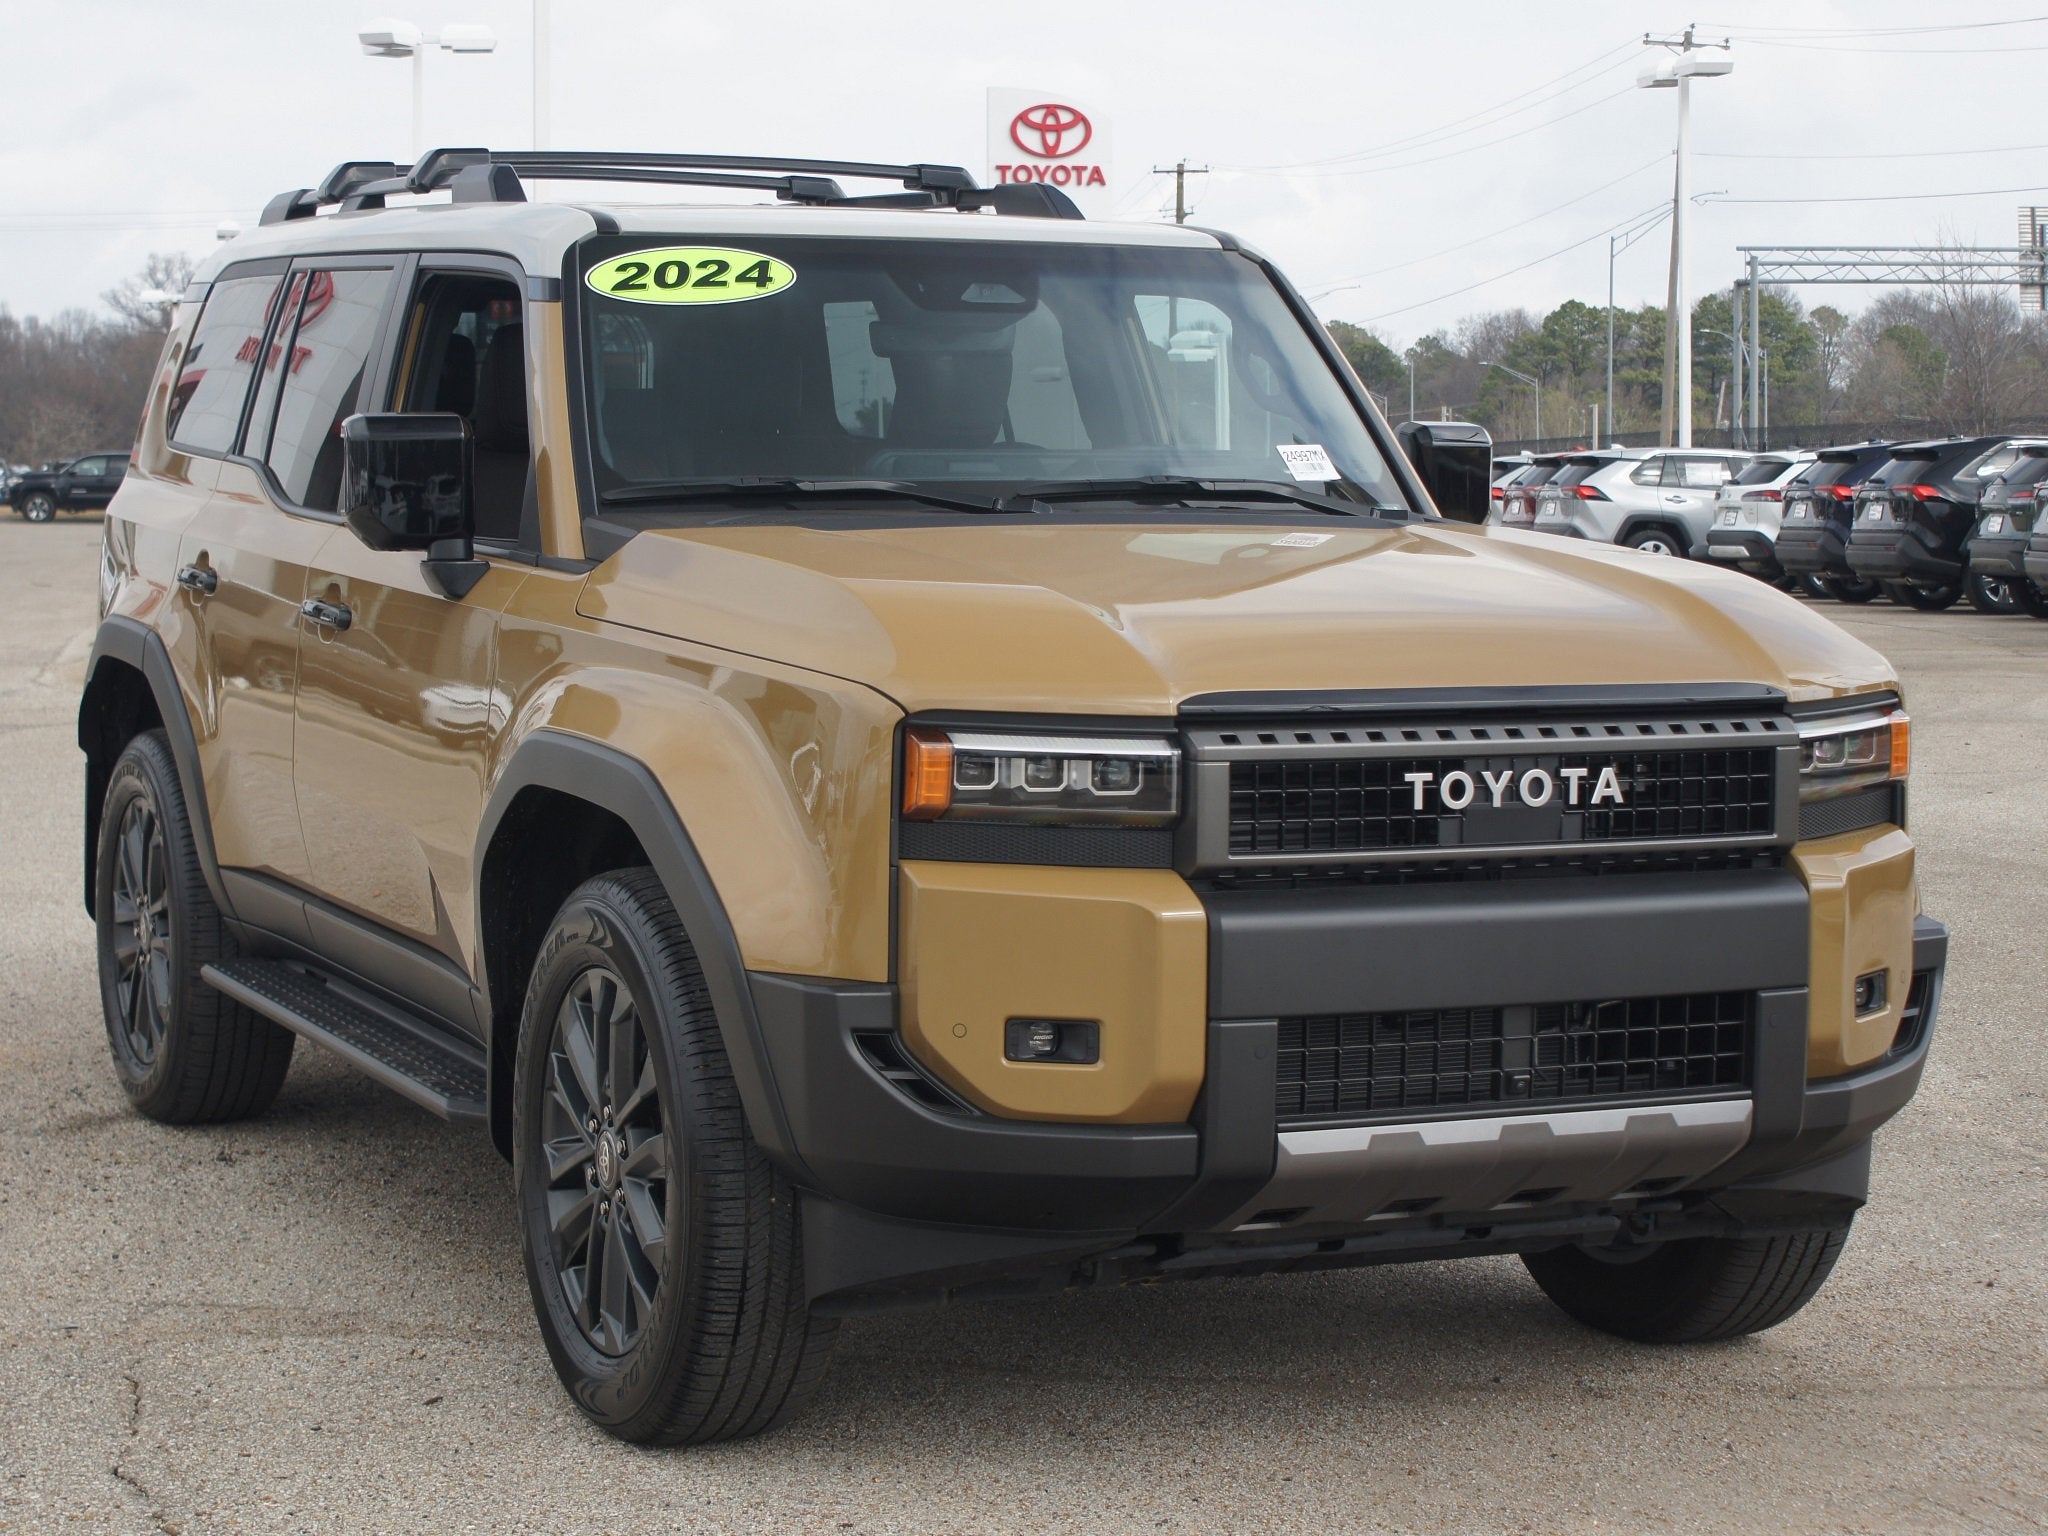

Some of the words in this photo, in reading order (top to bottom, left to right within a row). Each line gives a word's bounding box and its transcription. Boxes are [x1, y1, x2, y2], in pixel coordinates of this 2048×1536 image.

[995, 164, 1106, 186] TOYOTA
[610, 259, 775, 291] 2024
[1404, 767, 1624, 810] TOYOTA
